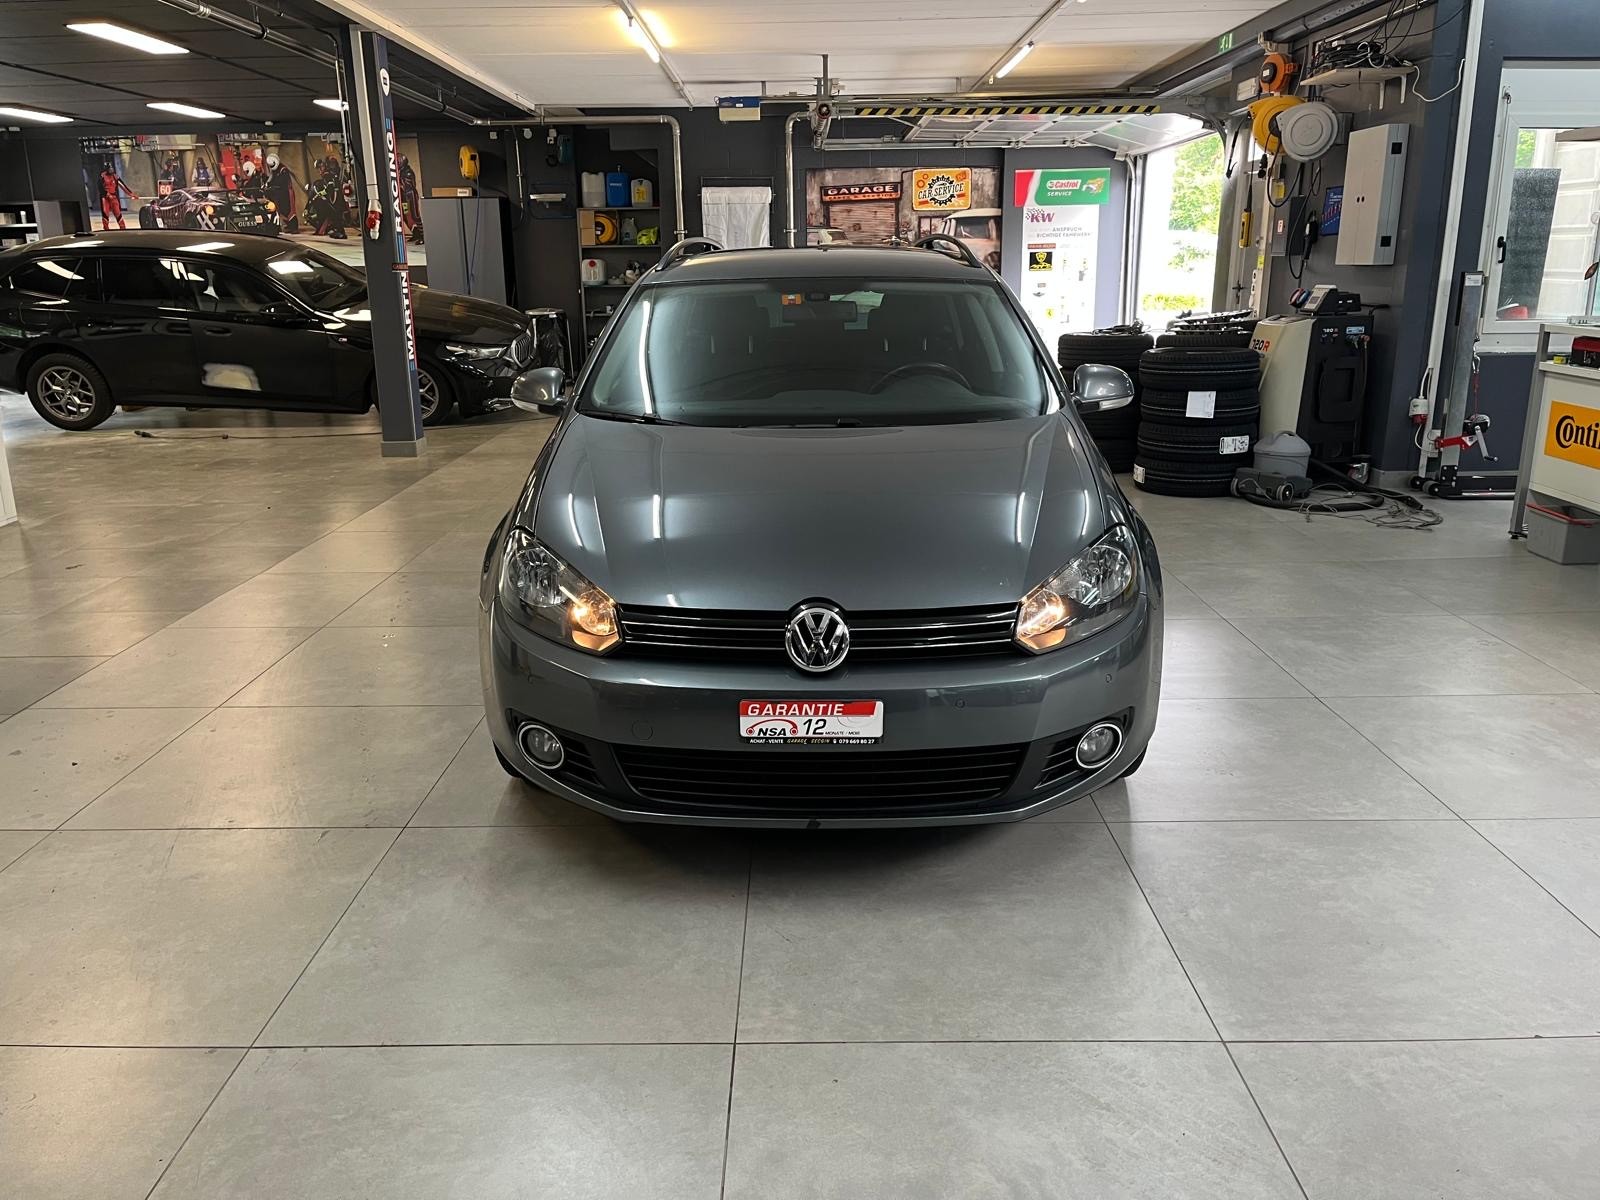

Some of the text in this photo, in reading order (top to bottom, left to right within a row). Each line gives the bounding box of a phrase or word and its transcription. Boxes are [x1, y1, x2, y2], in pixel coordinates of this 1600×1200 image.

[160, 185, 171, 195] 60
[827, 185, 895, 195] GARAGE
[918, 182, 964, 199] CAR SERVICE
[1031, 212, 1055, 223] KW
[386, 131, 415, 360] MARTIN RACING
[747, 703, 845, 716] GARANTIE
[757, 728, 787, 737] NSA
[803, 718, 827, 735] 12
